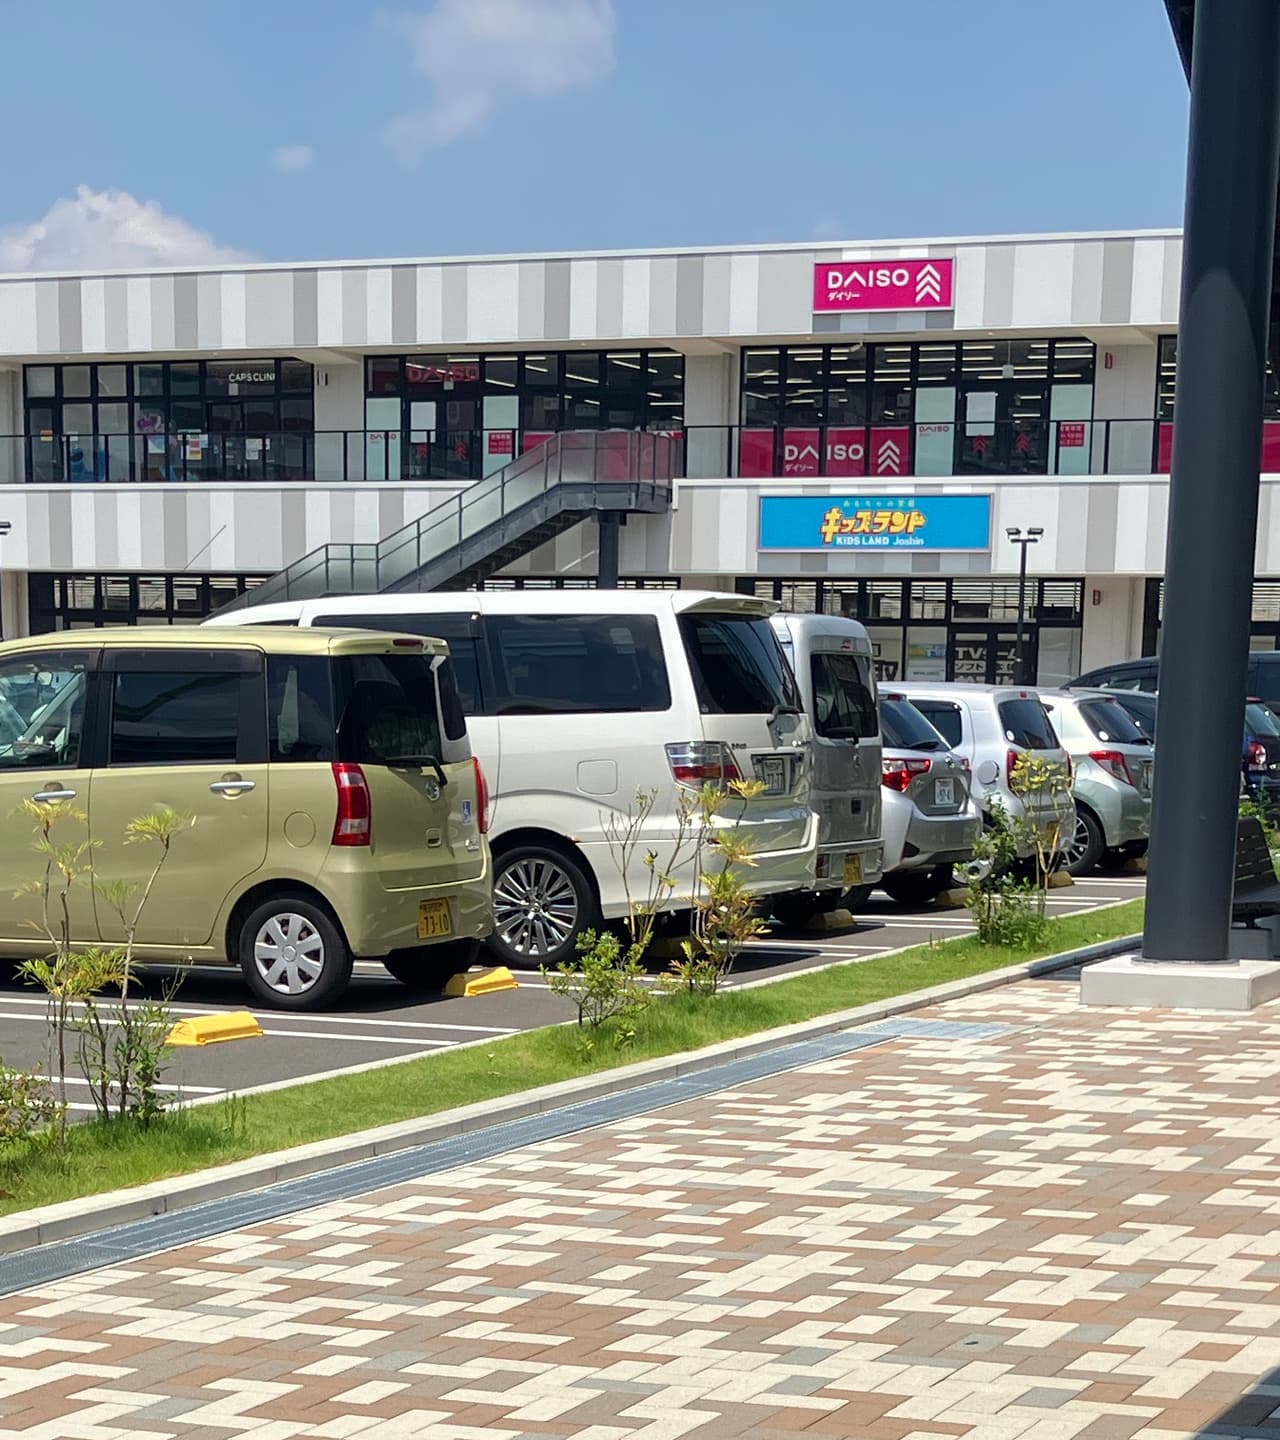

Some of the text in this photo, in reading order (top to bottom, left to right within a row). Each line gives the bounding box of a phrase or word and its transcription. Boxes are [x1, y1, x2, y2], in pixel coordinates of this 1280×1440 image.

[827, 269, 910, 288] DAISO
[827, 291, 860, 301] ダイソー
[784, 444, 865, 461] DAISO
[821, 508, 927, 544] キッズランド
[862, 536, 890, 546] LAND
[892, 536, 924, 546] Joshin
